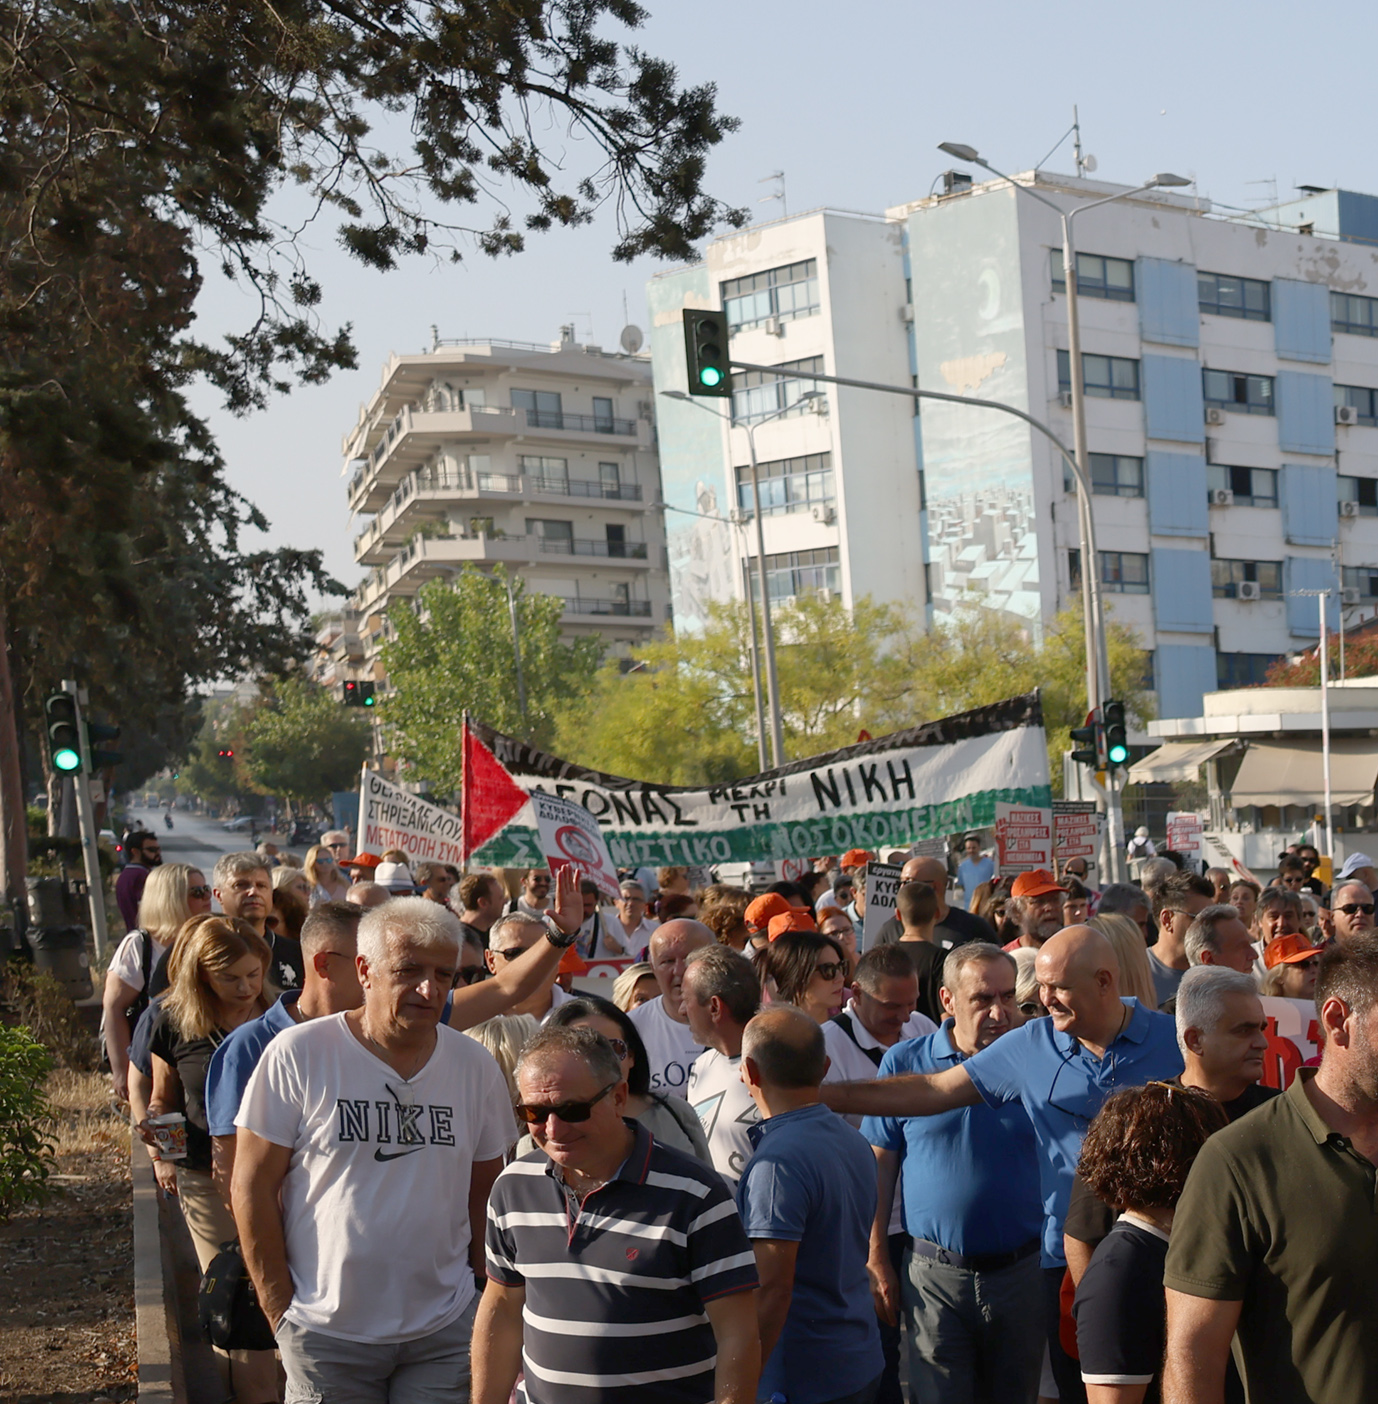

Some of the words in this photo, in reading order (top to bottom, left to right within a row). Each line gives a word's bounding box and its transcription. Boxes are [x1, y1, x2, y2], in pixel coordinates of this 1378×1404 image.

[535, 783, 698, 828] ΓΩΝΑΣ
[810, 758, 916, 812] ΝΙΚΗ
[730, 803, 770, 822] ΤΗ
[366, 825, 437, 857] ΜΕΤΑΤΡΟΠΗ
[770, 799, 974, 853] ΝΟΣΟΚΟΜΕΙΩΝ
[337, 1099, 455, 1146] NIKE
